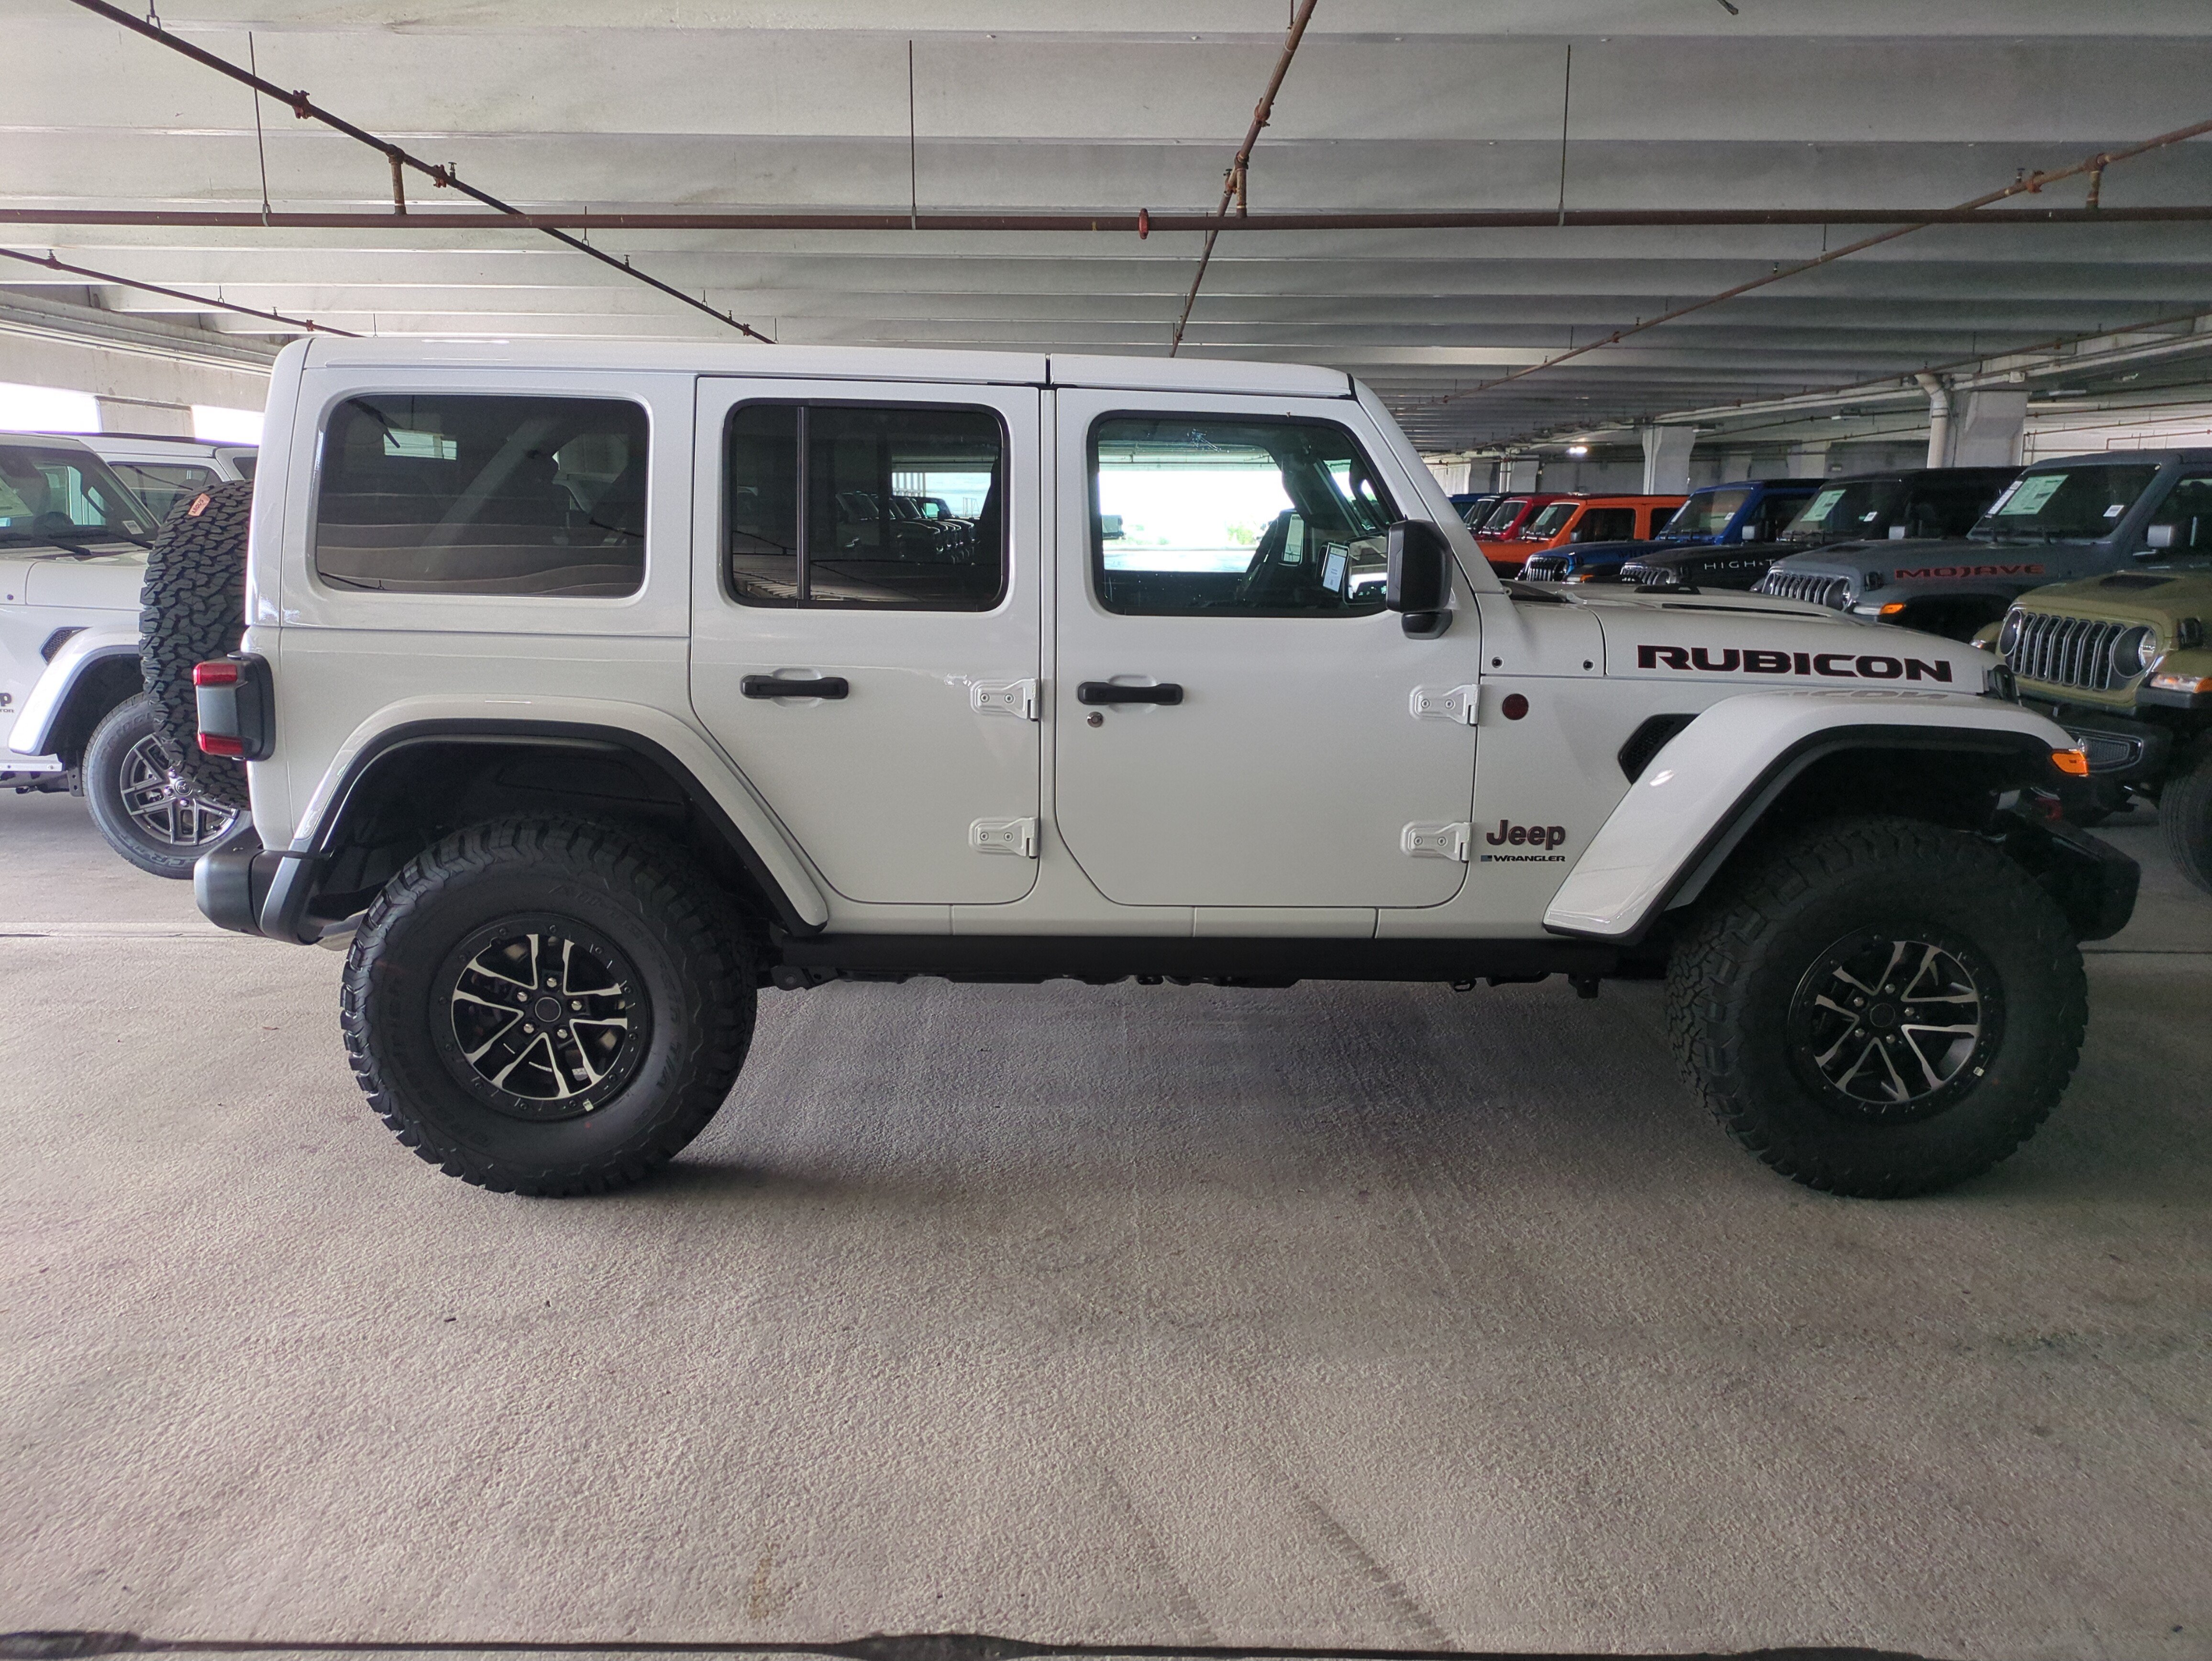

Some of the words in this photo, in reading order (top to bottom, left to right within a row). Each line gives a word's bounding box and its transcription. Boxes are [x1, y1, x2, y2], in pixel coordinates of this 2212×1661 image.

[1704, 560, 1756, 570] HIGH
[1895, 564, 2045, 580] MOJAVE
[1637, 644, 1953, 683] RUBICON
[1486, 819, 1566, 851] Jeep
